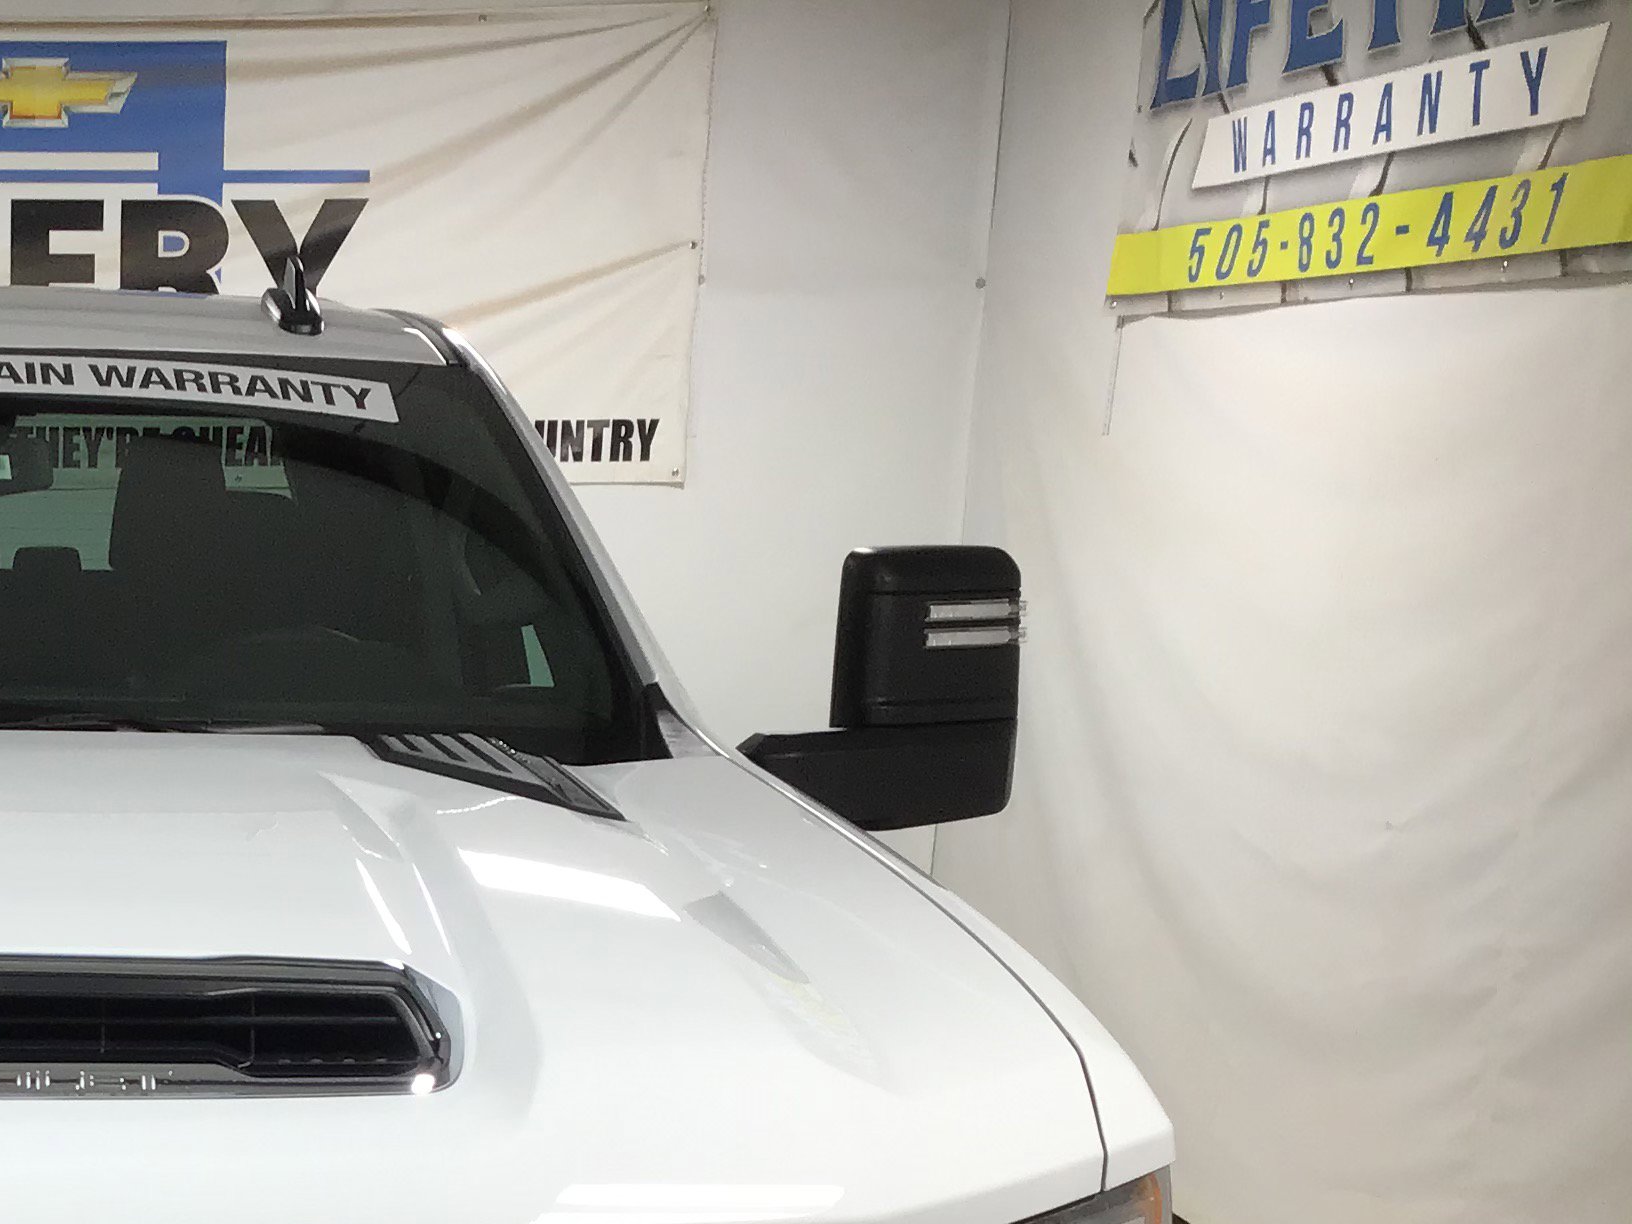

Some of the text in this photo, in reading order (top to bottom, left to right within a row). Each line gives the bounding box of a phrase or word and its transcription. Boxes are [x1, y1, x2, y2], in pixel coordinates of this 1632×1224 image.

[1231, 46, 1549, 174] WARRANTY
[1187, 171, 1569, 283] 505-832-4431
[90, 362, 373, 410] WARRANTY
[534, 418, 660, 462] UNTRY
